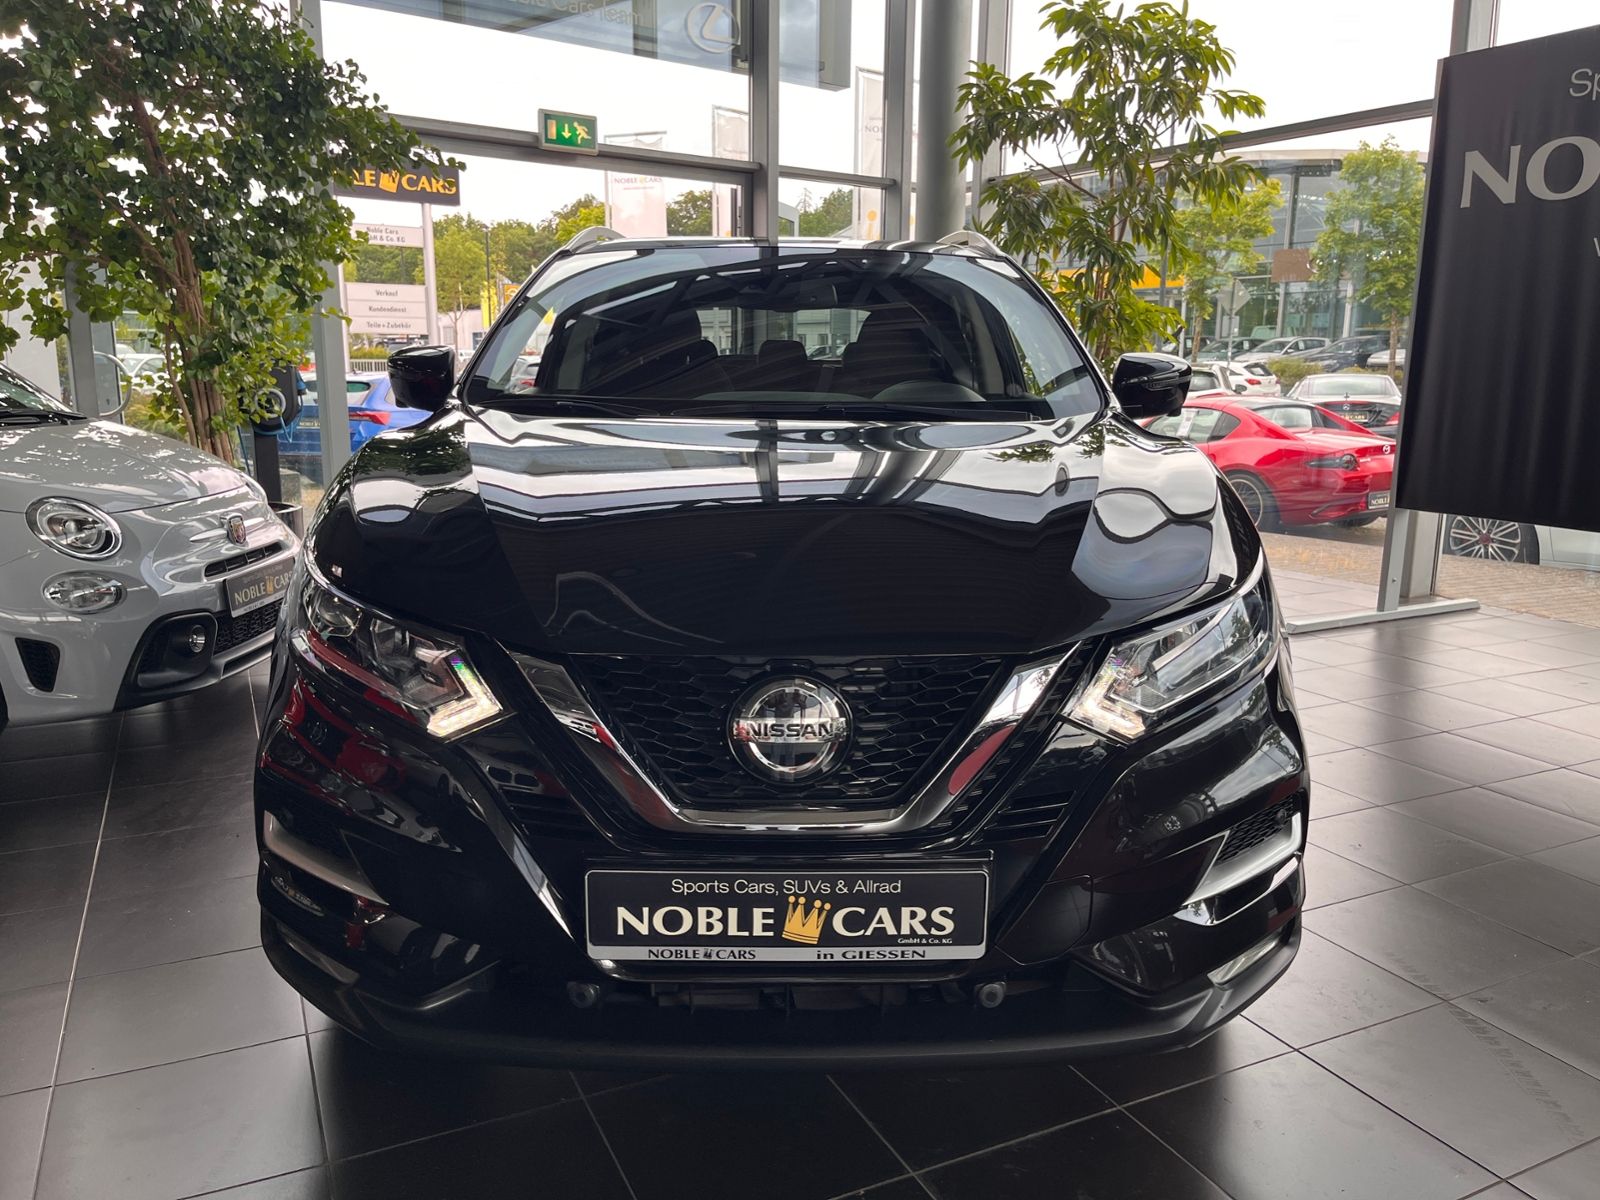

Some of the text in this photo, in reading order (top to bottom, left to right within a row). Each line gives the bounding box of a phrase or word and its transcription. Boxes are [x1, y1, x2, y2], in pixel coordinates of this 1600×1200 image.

[234, 582, 266, 606] NOBLE
[746, 723, 835, 738] NISSAN
[671, 879, 902, 896] Sports Cars, SUVs & Allrad
[616, 906, 955, 937] NOBLE CARS
[648, 949, 757, 960] NOBLE CARS
[816, 949, 926, 960] in GIESSEN
